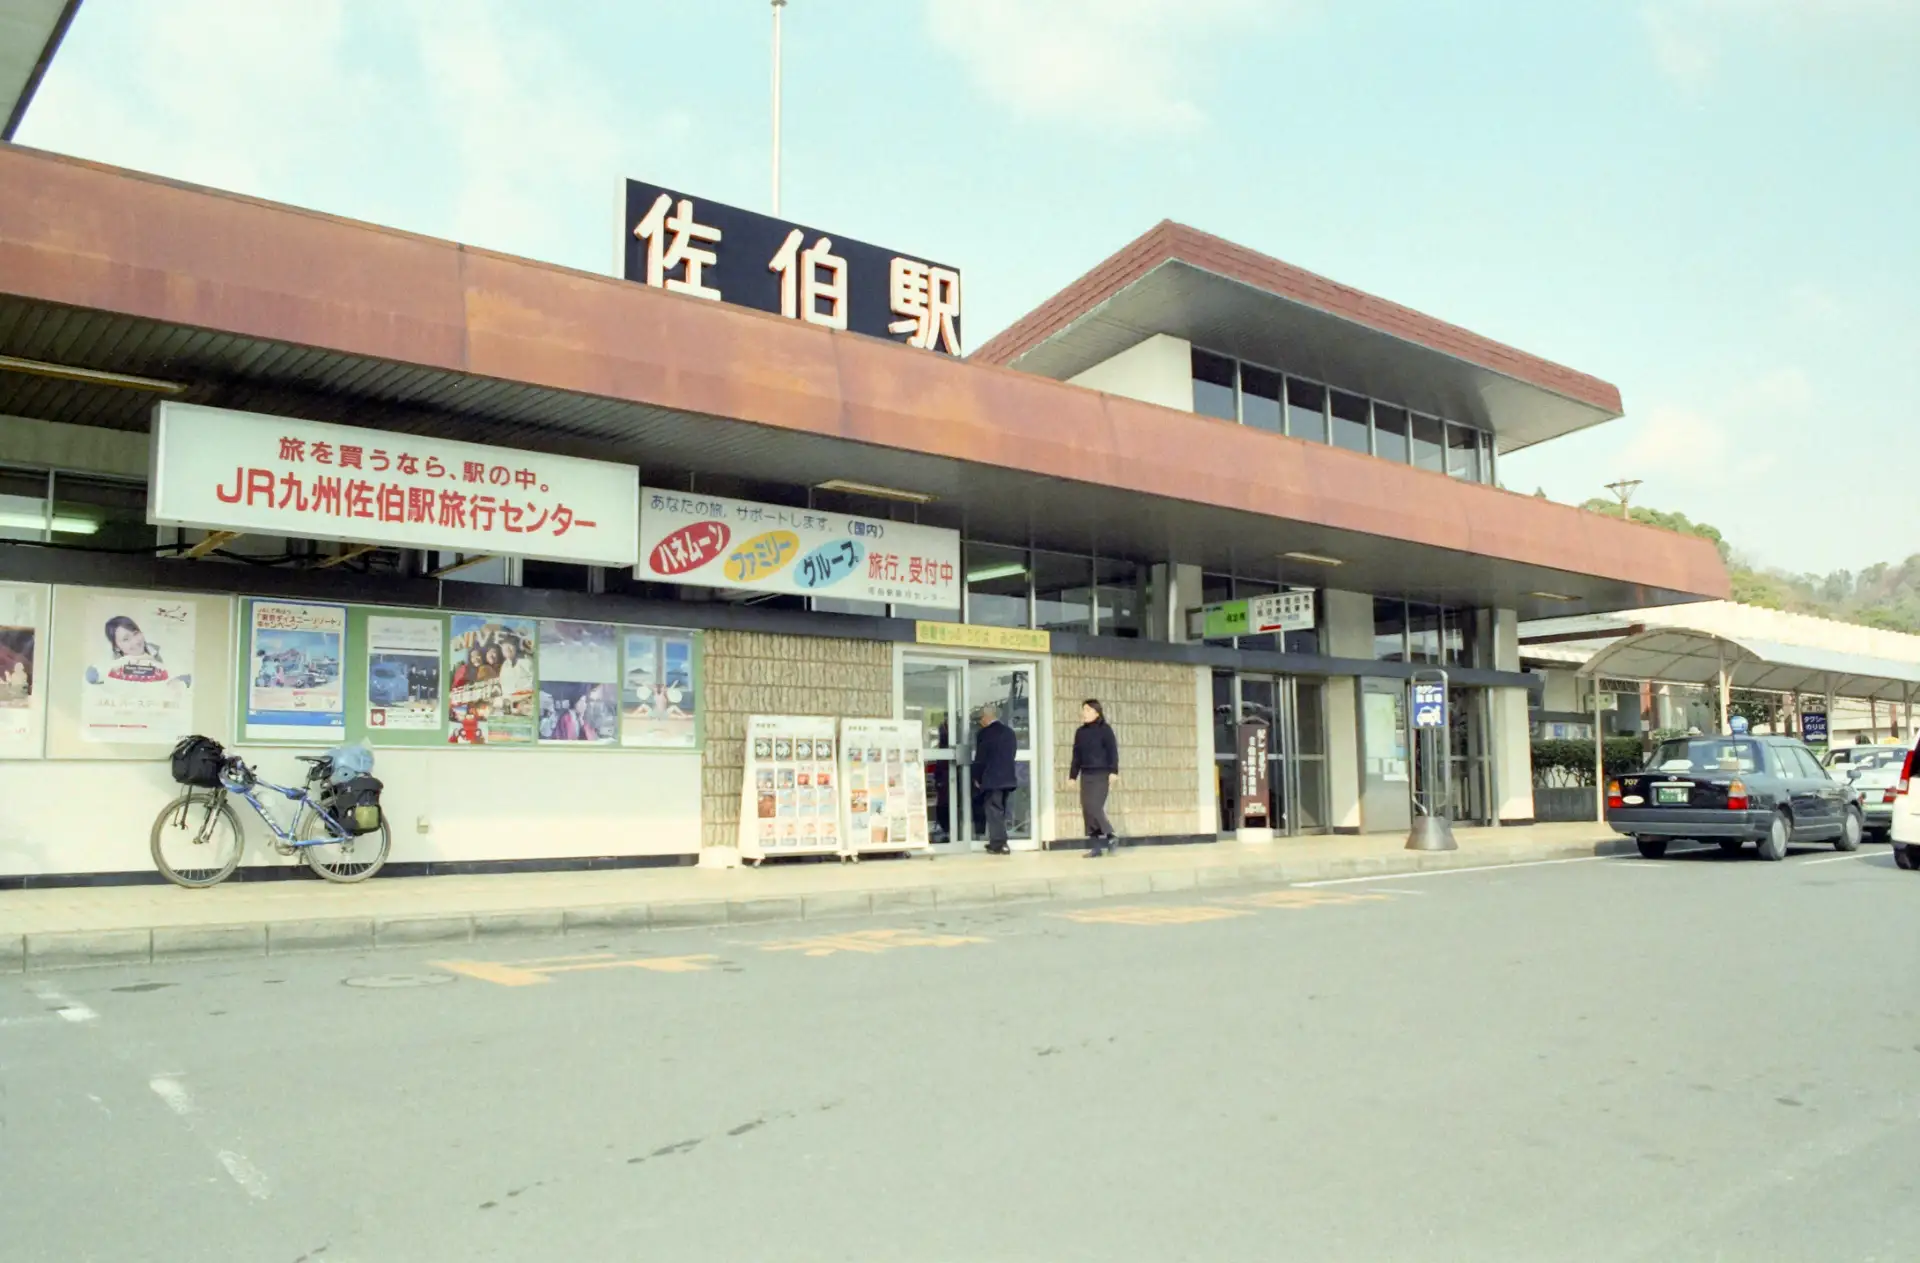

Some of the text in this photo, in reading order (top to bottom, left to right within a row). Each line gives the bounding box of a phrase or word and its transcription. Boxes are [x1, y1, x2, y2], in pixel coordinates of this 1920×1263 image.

[633, 193, 962, 357] 佐伯駅
[279, 435, 550, 493] 旅を買うなら、駅の中。
[215, 467, 597, 537] JR九州佐伯駅旅行センター
[658, 521, 726, 574] ハネムーン
[730, 536, 792, 580] ファミリー
[803, 540, 860, 588] グループ
